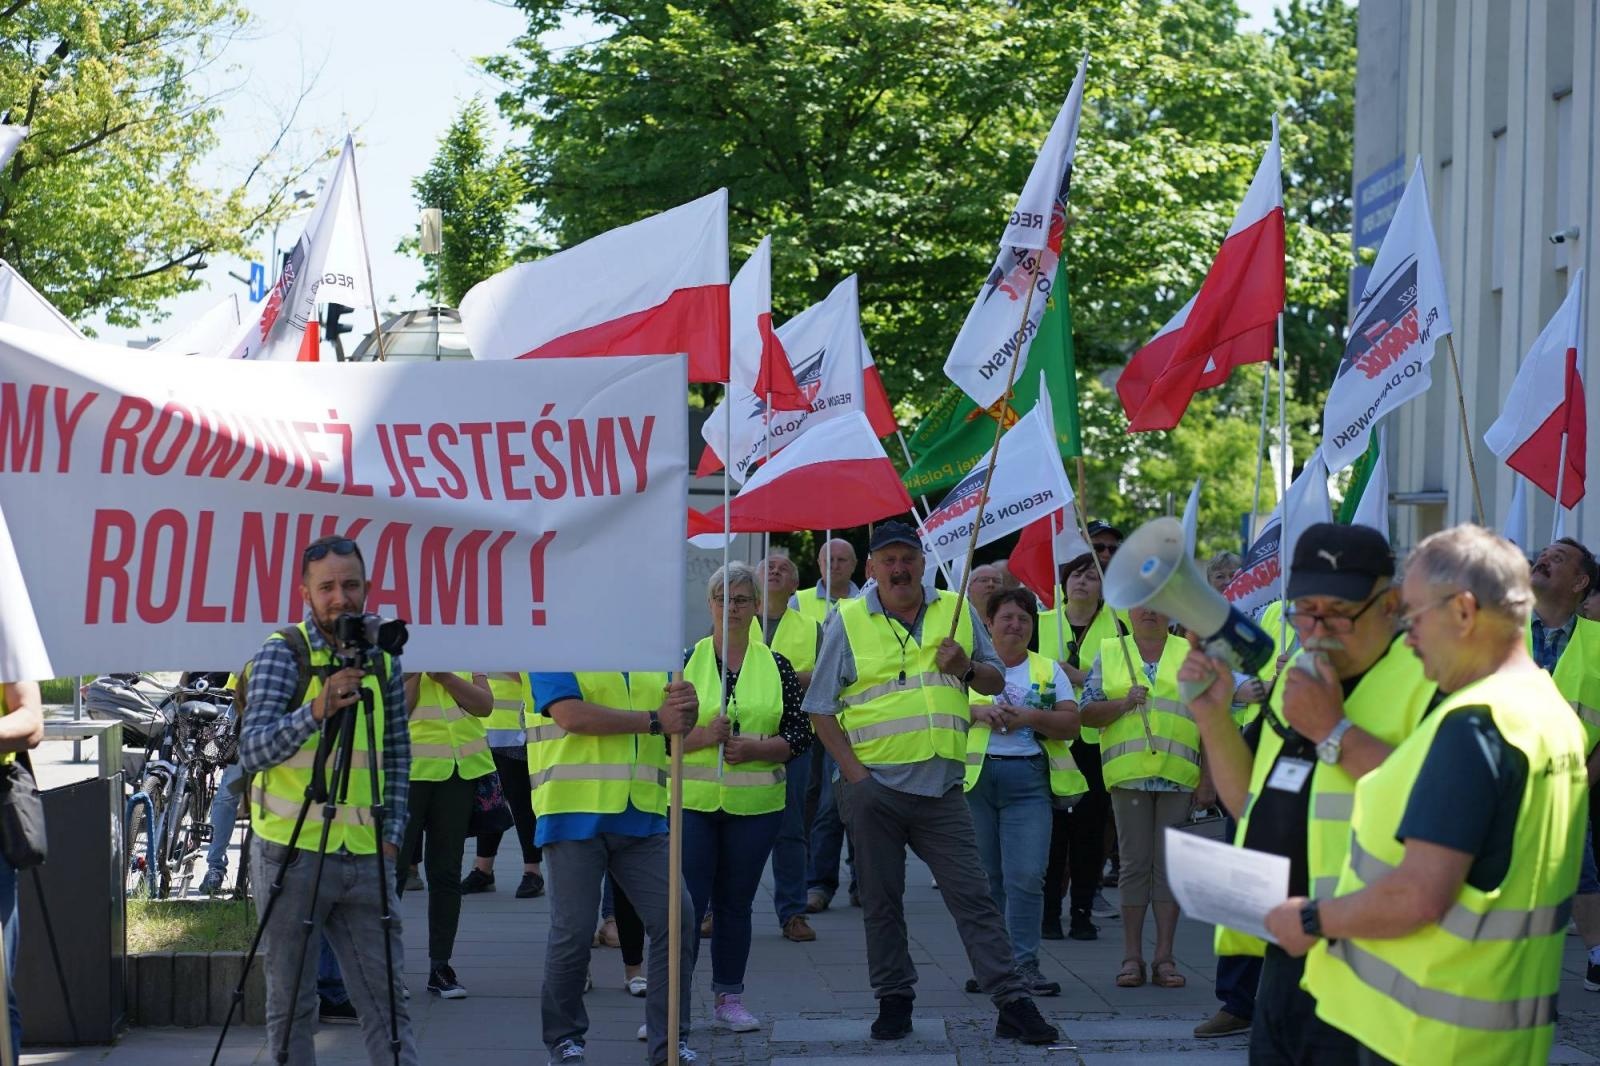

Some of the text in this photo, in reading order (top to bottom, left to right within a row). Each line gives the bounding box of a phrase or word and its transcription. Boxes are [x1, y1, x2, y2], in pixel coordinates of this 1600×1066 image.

[0, 382, 98, 474] MY
[376, 403, 656, 501] JESTEŚMY
[84, 507, 557, 626] ROLNIAMI !
